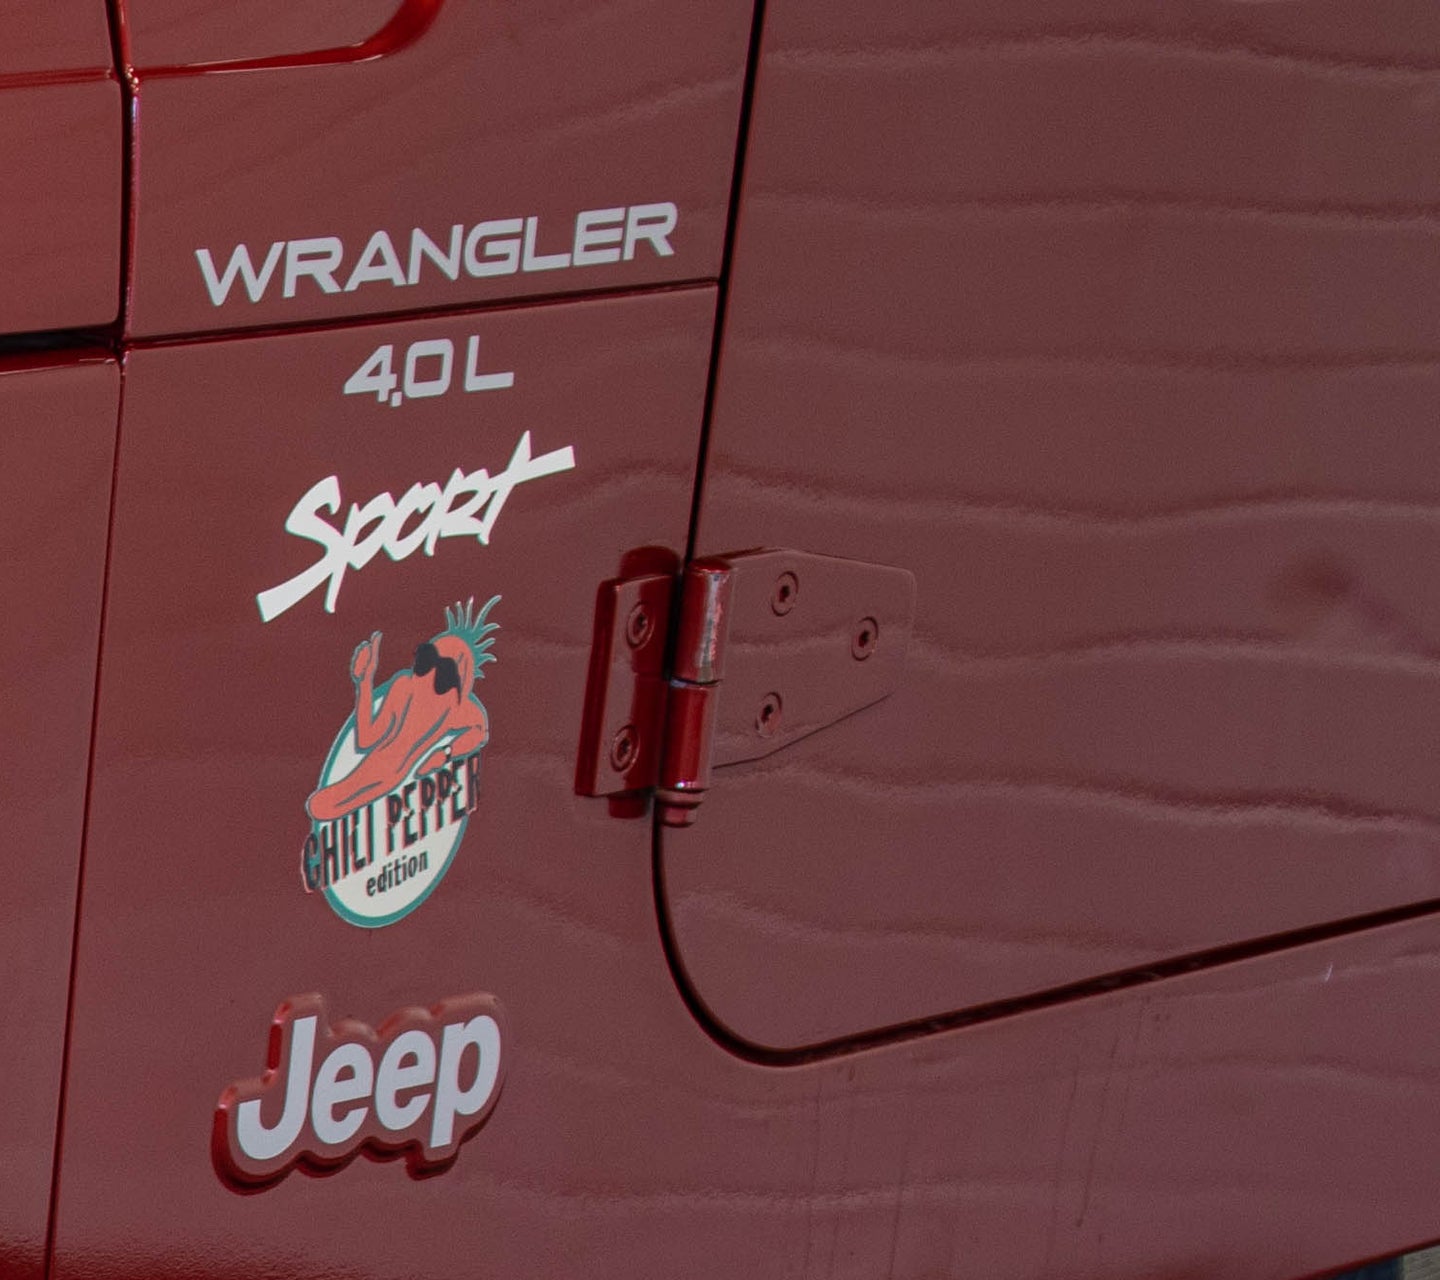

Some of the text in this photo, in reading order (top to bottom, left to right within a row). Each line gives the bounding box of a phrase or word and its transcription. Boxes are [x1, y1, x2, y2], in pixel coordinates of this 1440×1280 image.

[195, 202, 678, 306] WRANGLER
[302, 752, 481, 892] CHILI PEPPER
[366, 850, 428, 897] edition
[237, 1015, 502, 1161] Jeep
